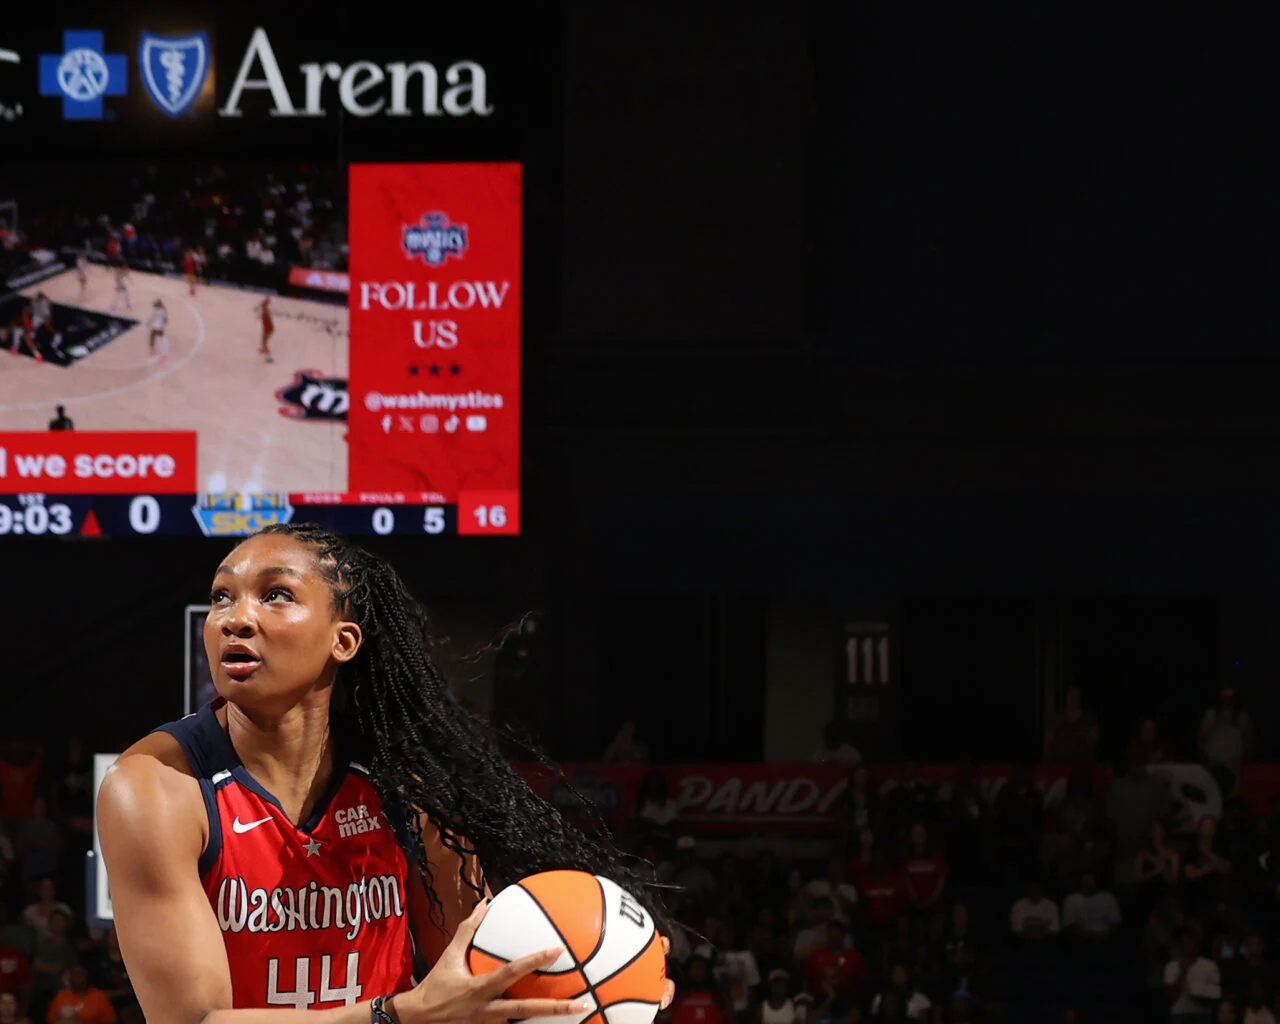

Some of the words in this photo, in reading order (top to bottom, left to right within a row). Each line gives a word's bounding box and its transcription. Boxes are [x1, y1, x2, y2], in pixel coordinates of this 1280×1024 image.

[219, 27, 493, 117] Arena
[359, 281, 509, 311] FOLLOW
[413, 319, 459, 349] US
[365, 391, 503, 411] @washmystics
[15, 454, 66, 478] we
[74, 454, 176, 478] score
[129, 495, 161, 534] 0
[210, 511, 278, 534] SKY
[371, 507, 394, 535] 0
[422, 507, 446, 534] 5
[473, 505, 506, 528] 16
[845, 637, 889, 684] 111
[334, 804, 369, 825] CAR
[338, 814, 381, 838] max
[217, 873, 404, 941] Washington
[266, 951, 362, 1010] 44
